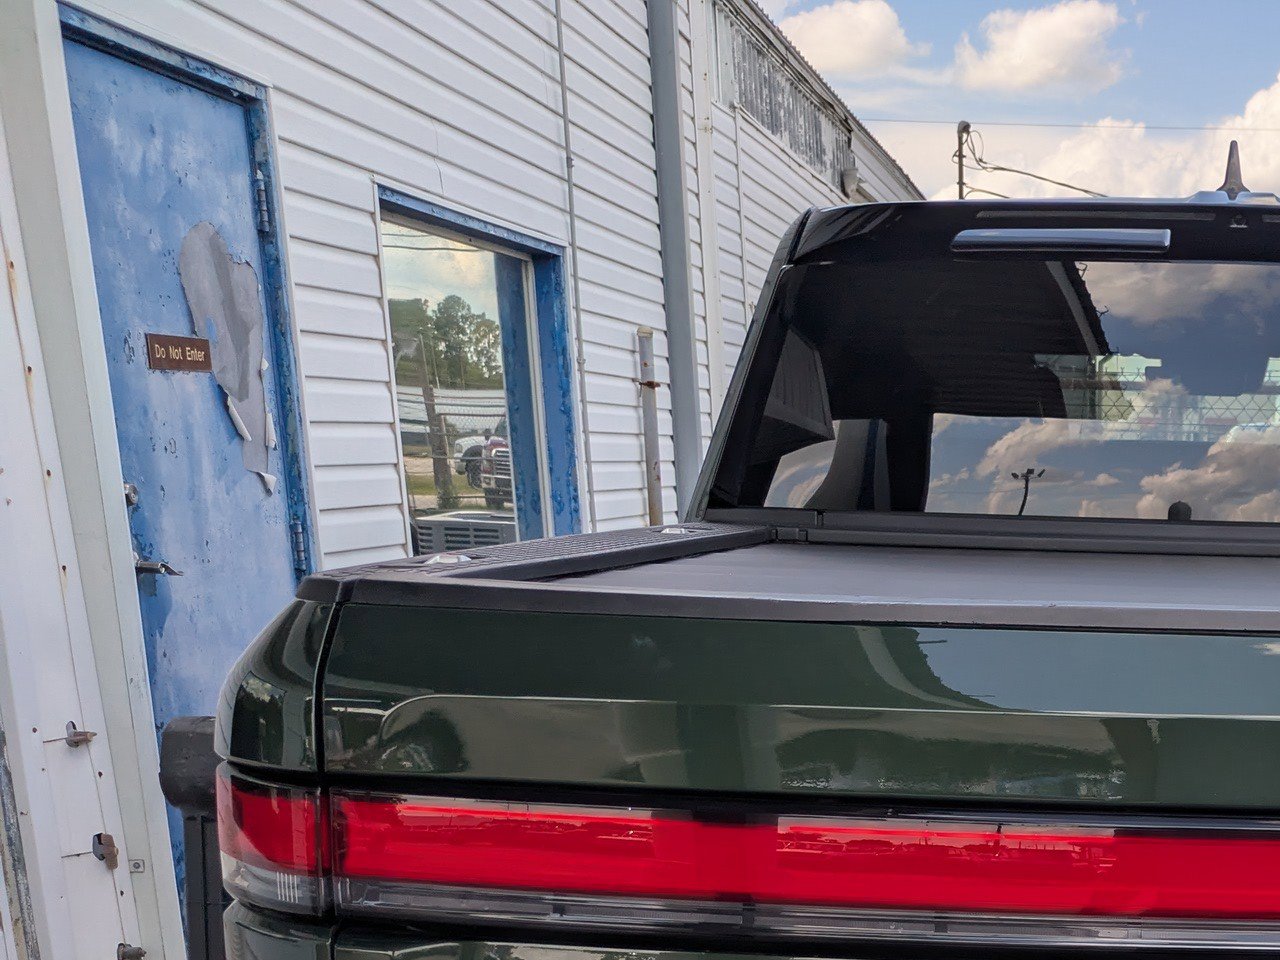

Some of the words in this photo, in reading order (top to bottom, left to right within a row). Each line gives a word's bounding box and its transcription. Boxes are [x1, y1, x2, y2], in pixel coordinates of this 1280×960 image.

[155, 344, 166, 358] Do
[169, 345, 183, 359] Not
[186, 347, 205, 361] Enter
